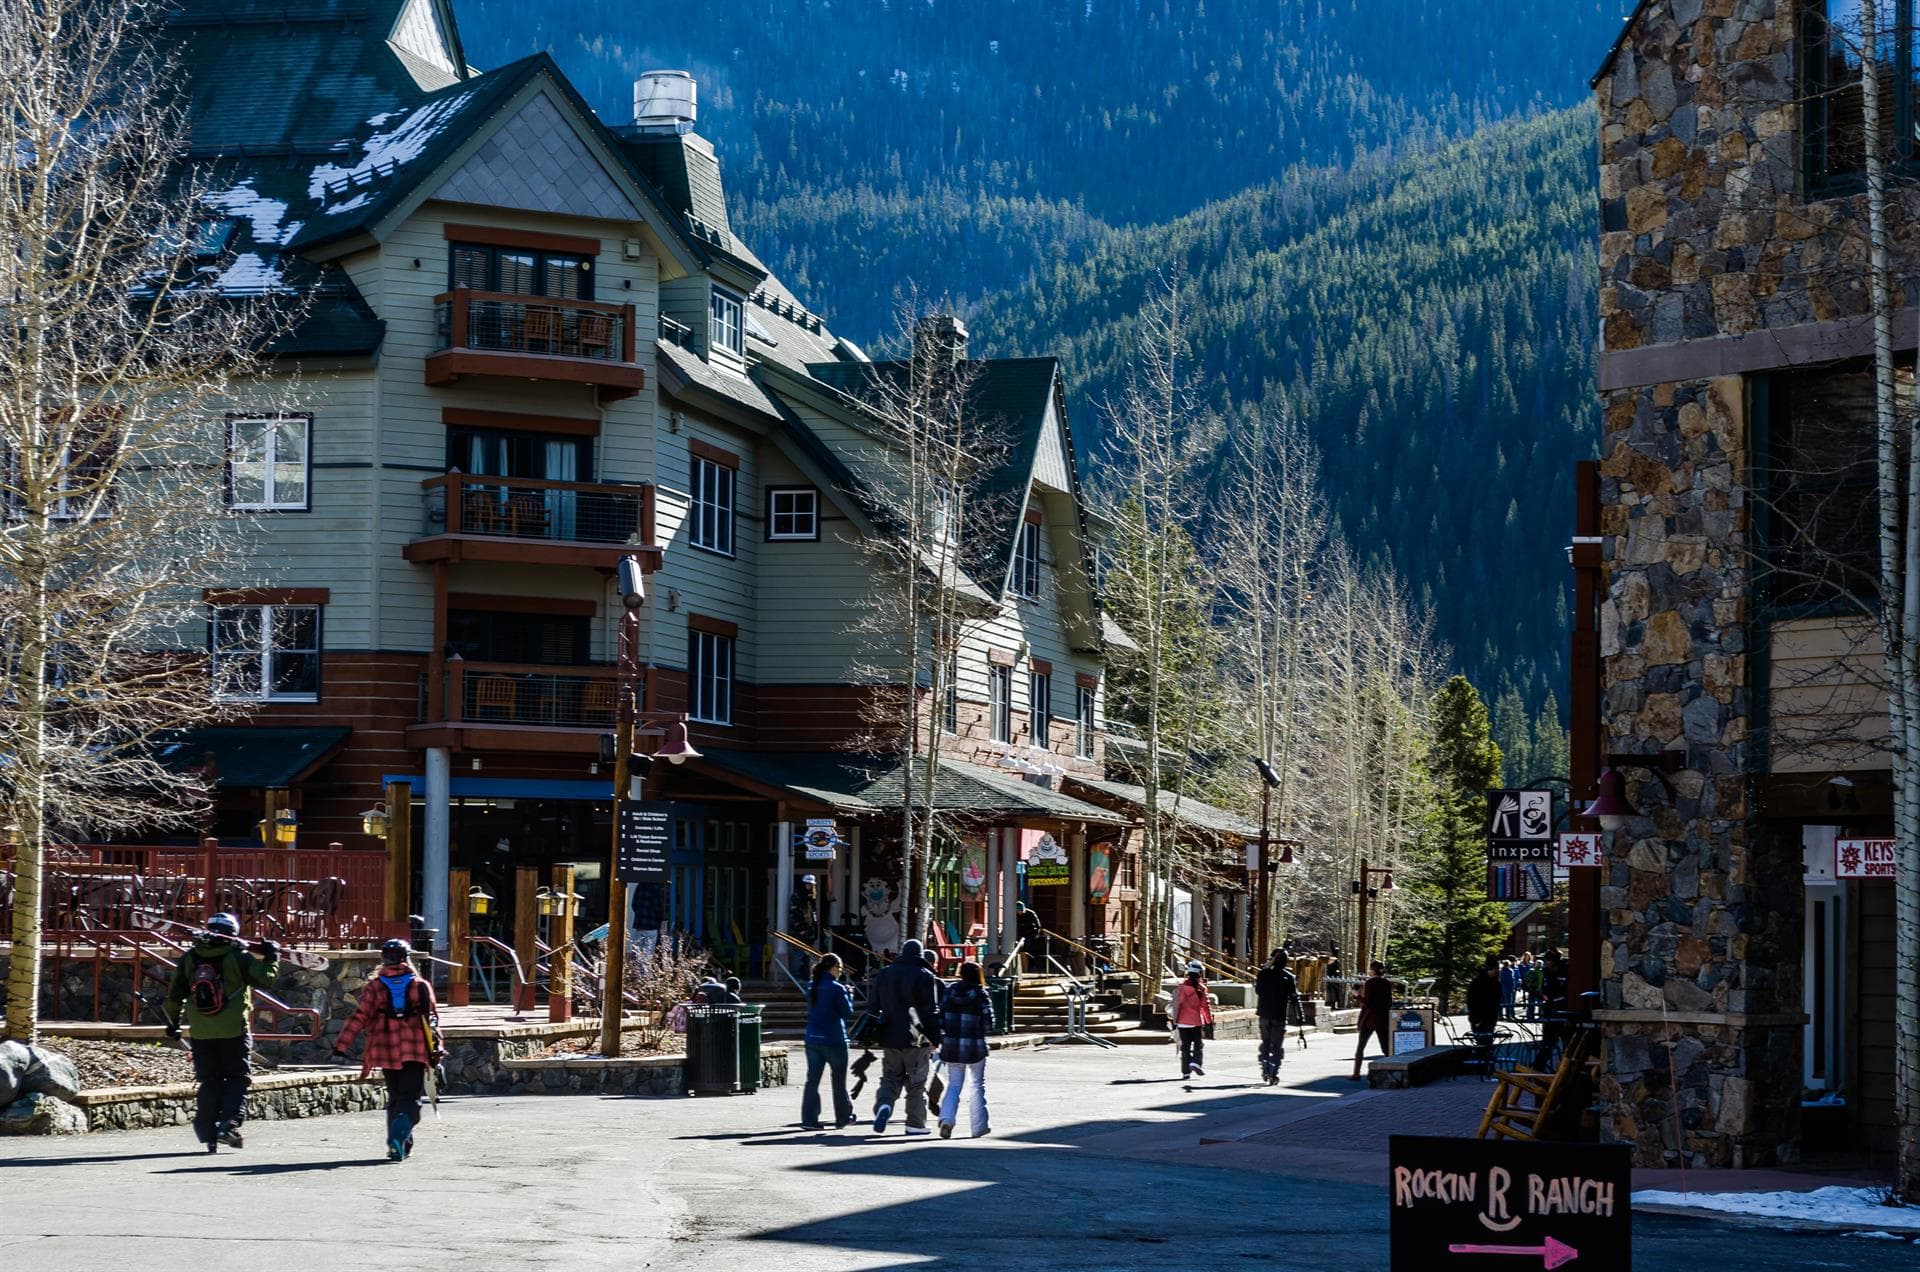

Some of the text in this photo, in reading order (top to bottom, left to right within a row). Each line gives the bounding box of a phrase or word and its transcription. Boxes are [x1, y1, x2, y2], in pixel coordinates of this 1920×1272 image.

[1491, 842, 1549, 860] inxpot
[1864, 862, 1896, 875] SPORTS
[1394, 1165, 1615, 1220] ROCKIN R RANCH
